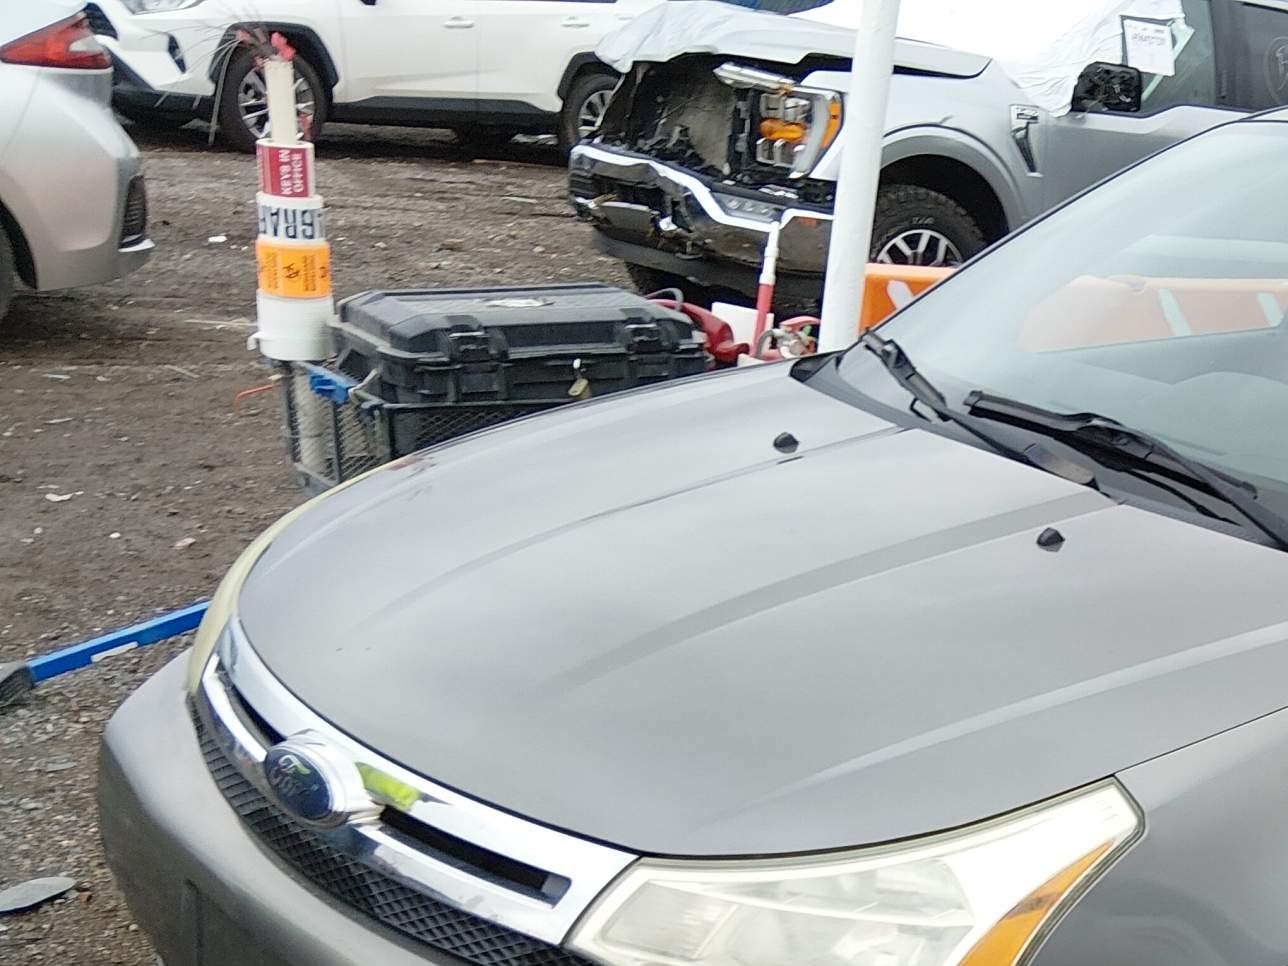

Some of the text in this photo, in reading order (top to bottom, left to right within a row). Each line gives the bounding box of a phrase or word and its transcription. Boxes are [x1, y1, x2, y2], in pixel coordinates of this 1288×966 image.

[278, 149, 293, 196] KEYS IN
[291, 152, 305, 193] OFFICE
